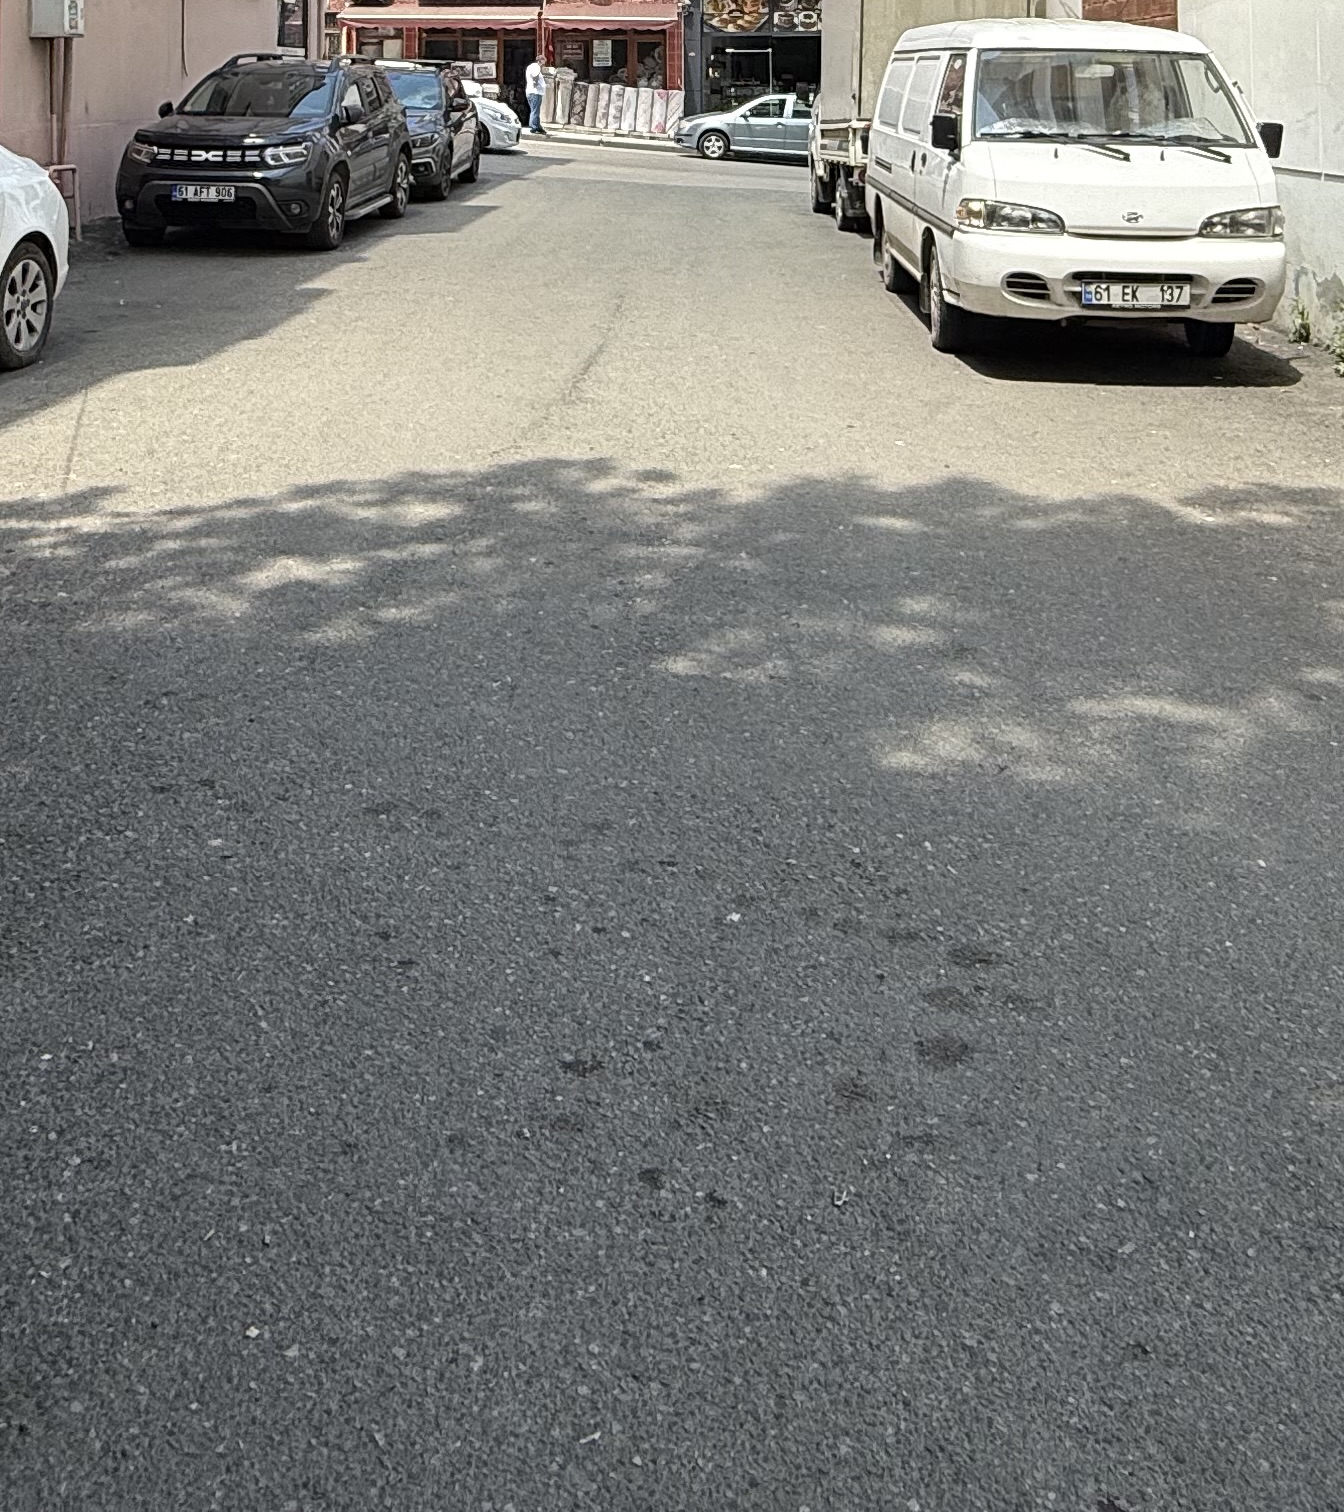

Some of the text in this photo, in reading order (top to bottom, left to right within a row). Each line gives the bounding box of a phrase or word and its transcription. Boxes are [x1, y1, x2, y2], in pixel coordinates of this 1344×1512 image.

[1094, 284, 1184, 303] 61 EK 137
